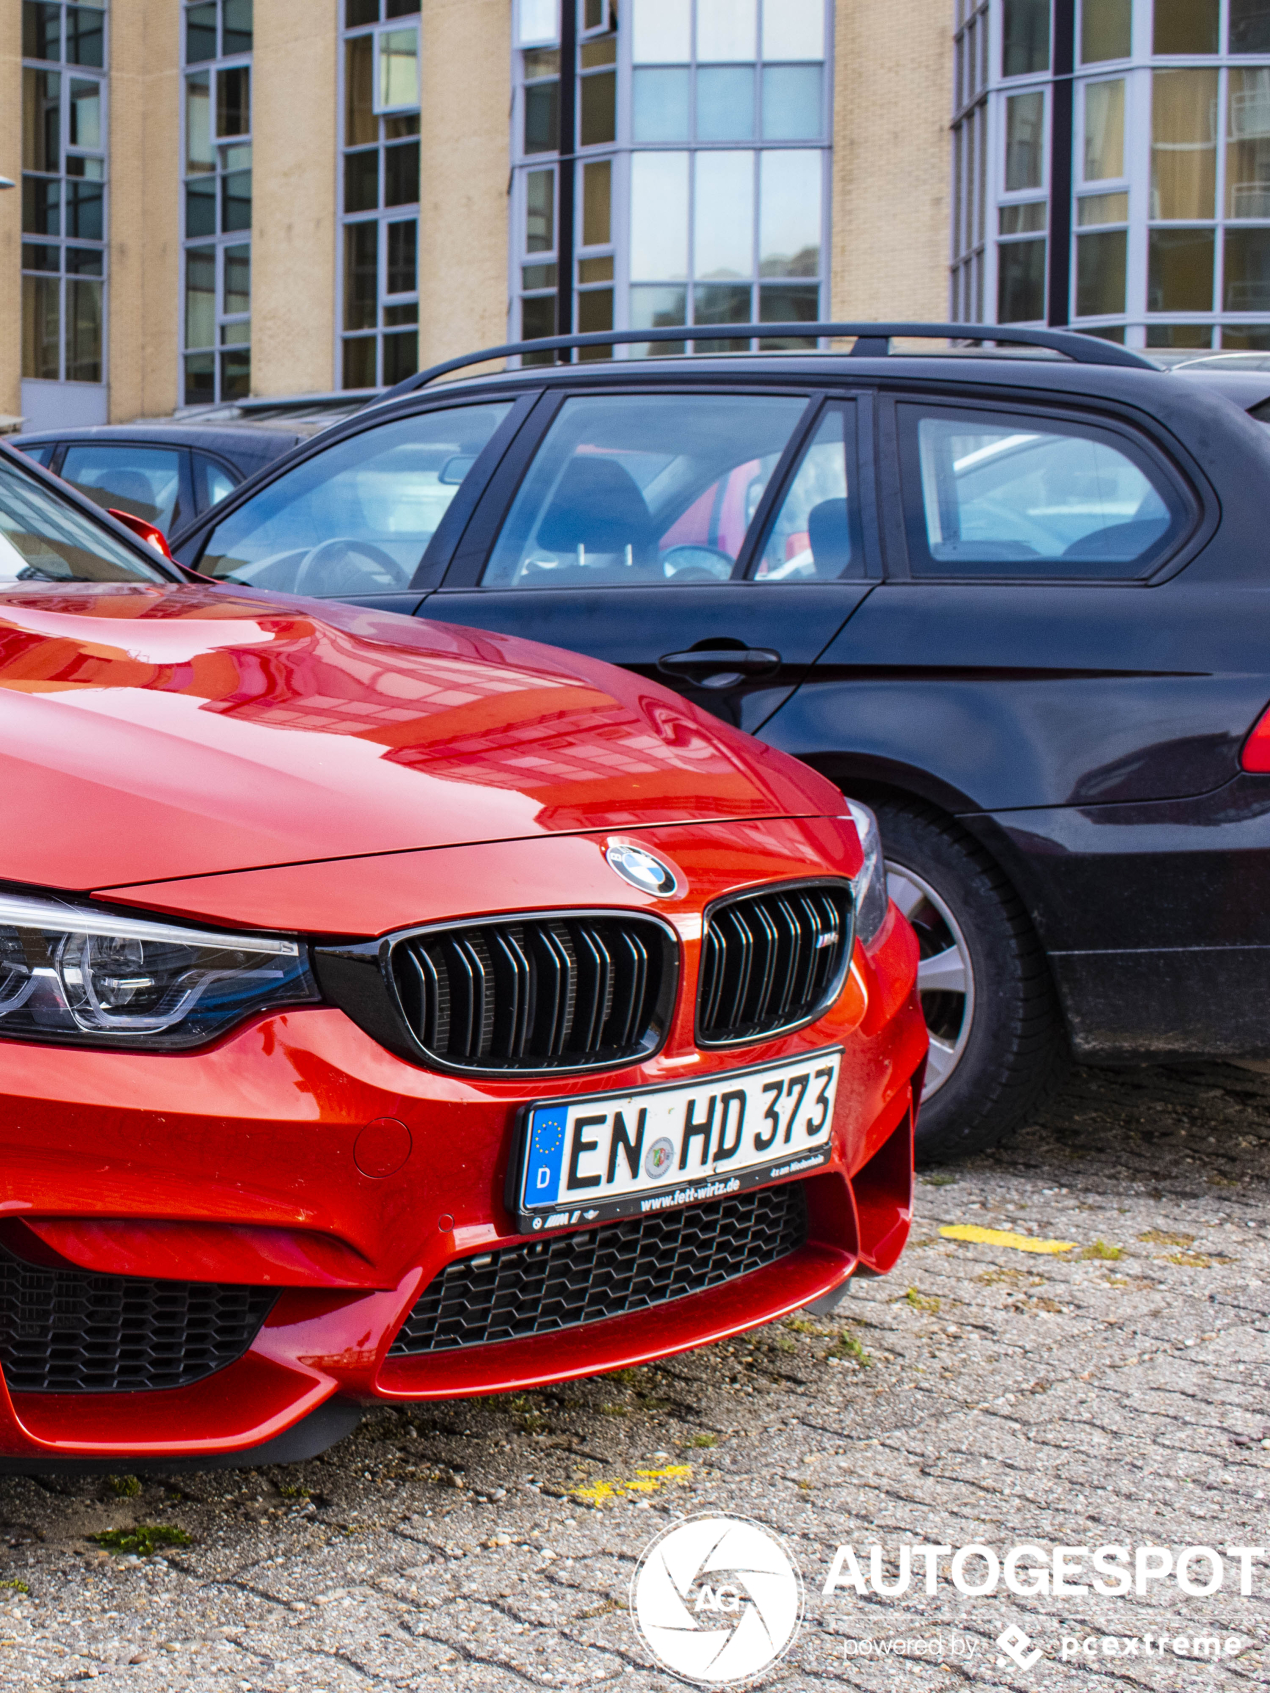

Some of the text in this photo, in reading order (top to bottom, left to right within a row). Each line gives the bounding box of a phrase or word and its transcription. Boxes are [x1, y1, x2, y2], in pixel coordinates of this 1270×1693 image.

[566, 1107, 648, 1191] EN
[679, 1088, 747, 1171] HD
[753, 1065, 835, 1152] 373
[536, 1168, 551, 1190] D
[640, 1177, 741, 1212] www.fett-wirtz.de
